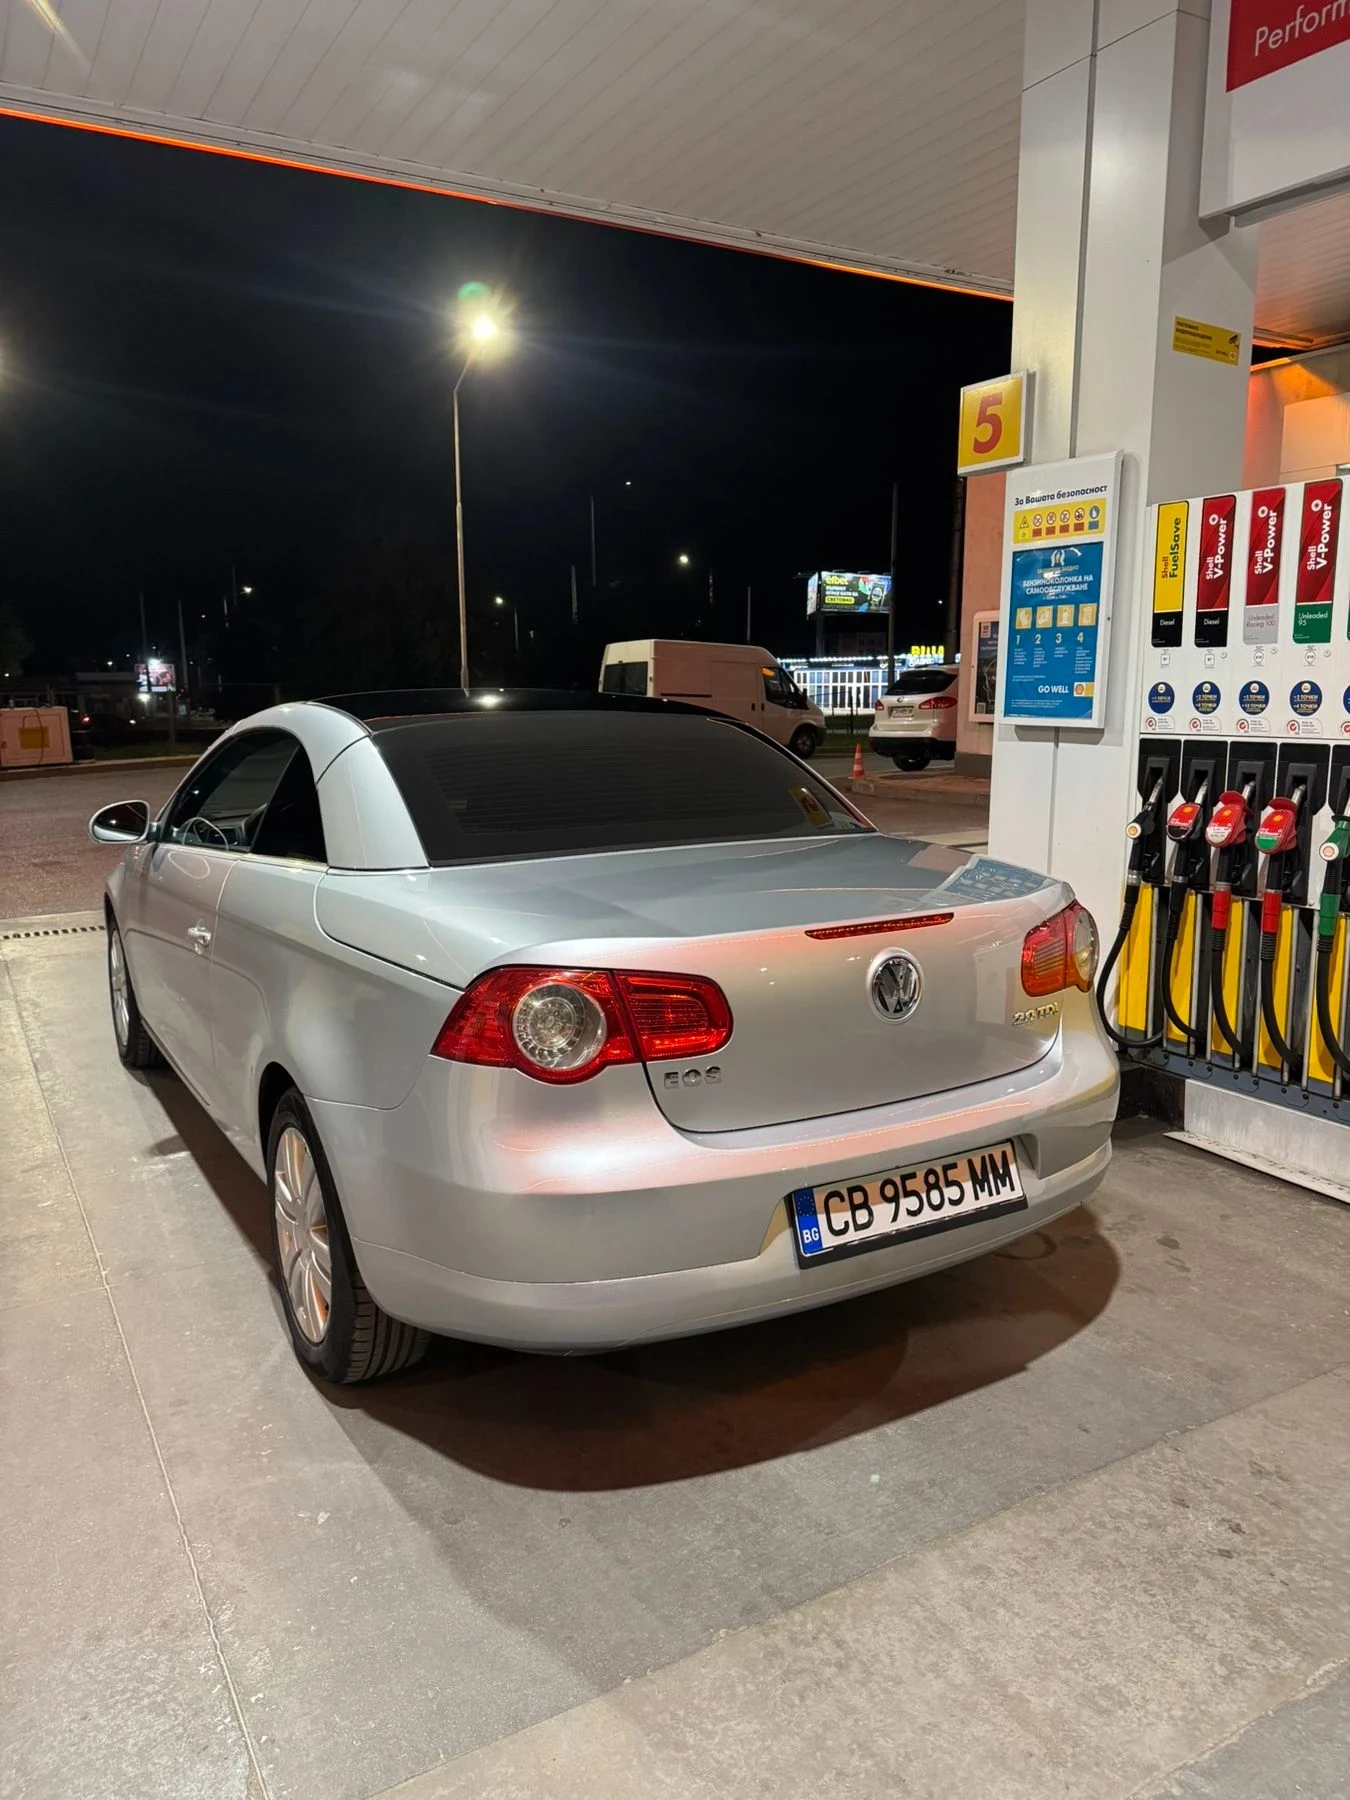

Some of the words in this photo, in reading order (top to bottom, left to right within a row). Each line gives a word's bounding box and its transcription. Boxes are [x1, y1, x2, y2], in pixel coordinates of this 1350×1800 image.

[972, 391, 1003, 454] 5
[1014, 497, 1024, 506] За
[1025, 493, 1055, 504] Вашата
[1056, 484, 1108, 499] безопасност
[1169, 517, 1181, 578] FuelSave
[1263, 509, 1278, 574] V-Power
[1316, 503, 1332, 570] V-Power
[1213, 518, 1227, 579] V-Power
[1307, 545, 1316, 571] Shell
[1161, 556, 1169, 579] Shell
[1205, 556, 1214, 580] Shell
[1254, 550, 1263, 575] Shell
[1083, 574, 1094, 582] НА
[1159, 618, 1175, 626] Diesel
[1203, 617, 1220, 626] Diesel
[1298, 611, 1328, 620] Unleaded
[1016, 634, 1020, 645] 1
[1035, 634, 1042, 644] 2
[1056, 633, 1062, 644] 3
[1077, 632, 1084, 643] 4
[1038, 685, 1050, 693] GO
[1050, 685, 1069, 693] WELL
[663, 1065, 722, 1090] EOS
[879, 1161, 965, 1223] 9585
[801, 1227, 819, 1244] BG
